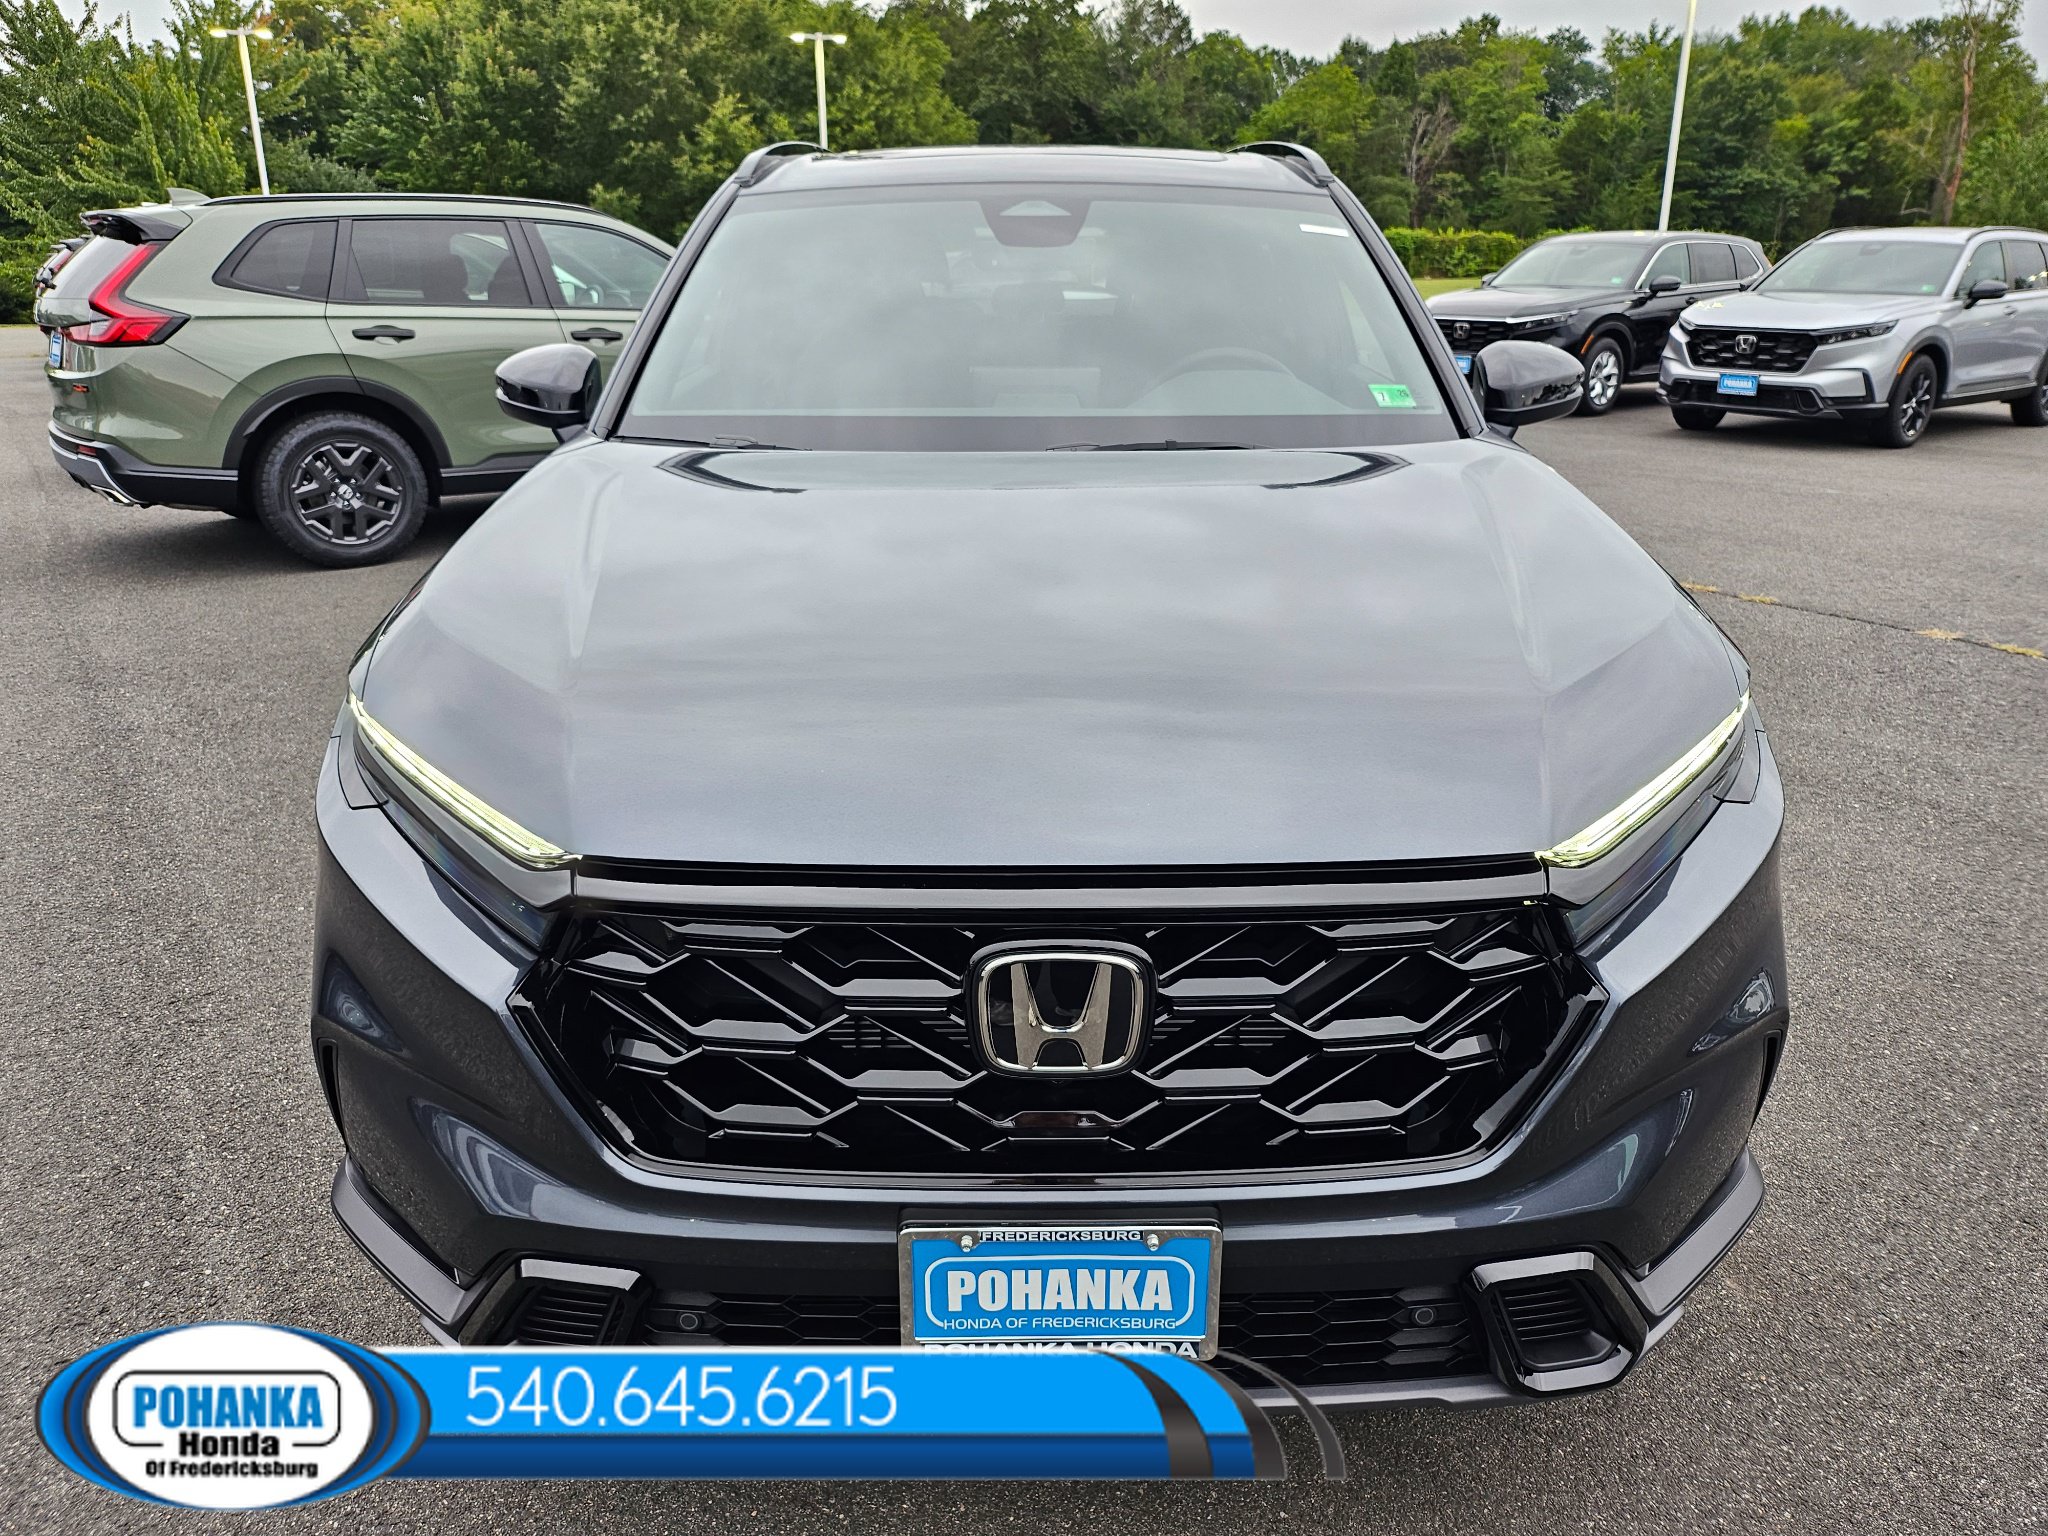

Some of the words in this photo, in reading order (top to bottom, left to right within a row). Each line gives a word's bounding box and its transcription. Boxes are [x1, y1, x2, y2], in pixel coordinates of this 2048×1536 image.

[981, 1230, 1142, 1242] FREDERICKSBURG
[946, 1268, 1174, 1312] POHANKA
[943, 1318, 1003, 1330] HONDA
[1005, 1317, 1029, 1329] OF
[1032, 1316, 1176, 1329] FREDERICKSBURG
